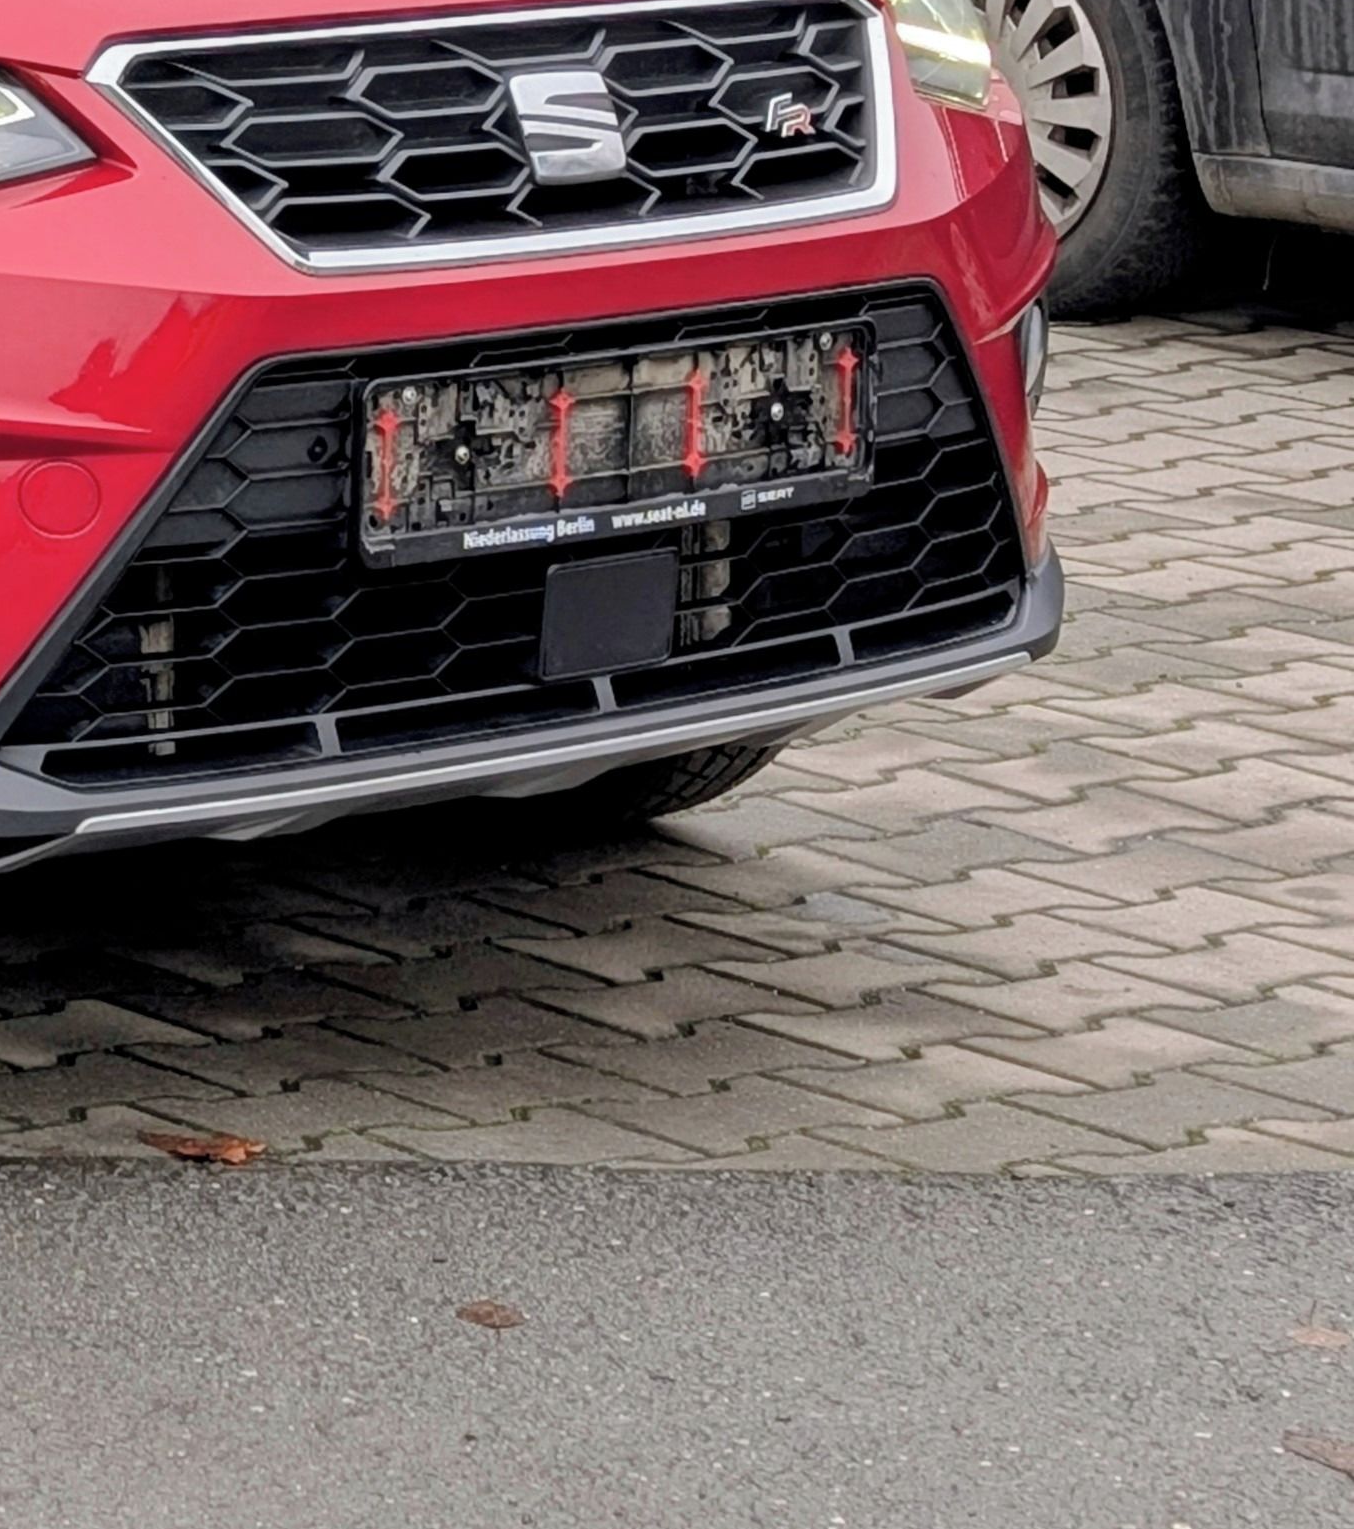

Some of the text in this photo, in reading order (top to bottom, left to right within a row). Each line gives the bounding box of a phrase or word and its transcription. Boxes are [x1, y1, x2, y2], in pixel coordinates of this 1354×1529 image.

[766, 92, 816, 138] FR
[757, 487, 795, 503] SEAT
[463, 524, 555, 550] Niederlassung
[557, 517, 595, 538] Berlin
